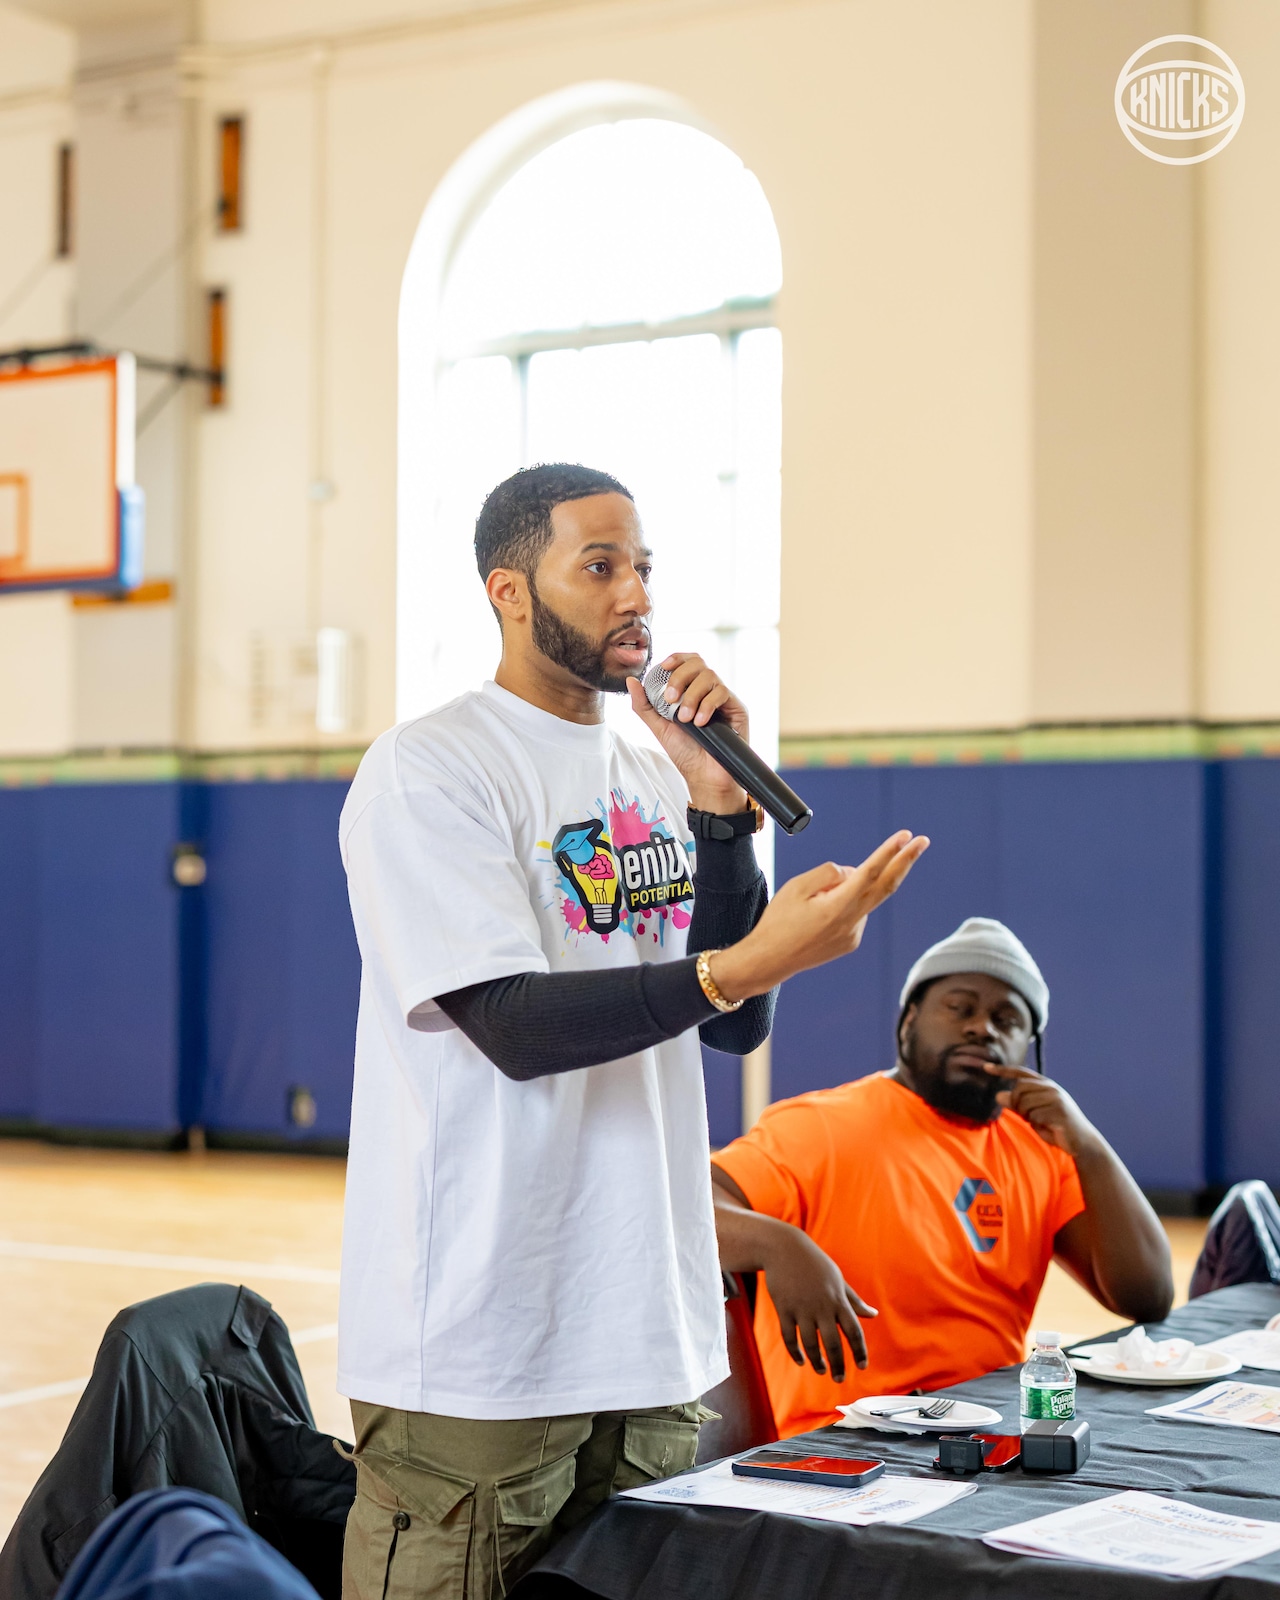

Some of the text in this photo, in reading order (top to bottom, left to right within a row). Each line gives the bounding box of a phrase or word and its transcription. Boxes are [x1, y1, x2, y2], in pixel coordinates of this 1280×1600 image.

[614, 836, 688, 890] eniu
[630, 880, 693, 907] POTENTIA
[1052, 1400, 1075, 1416] Sprin
